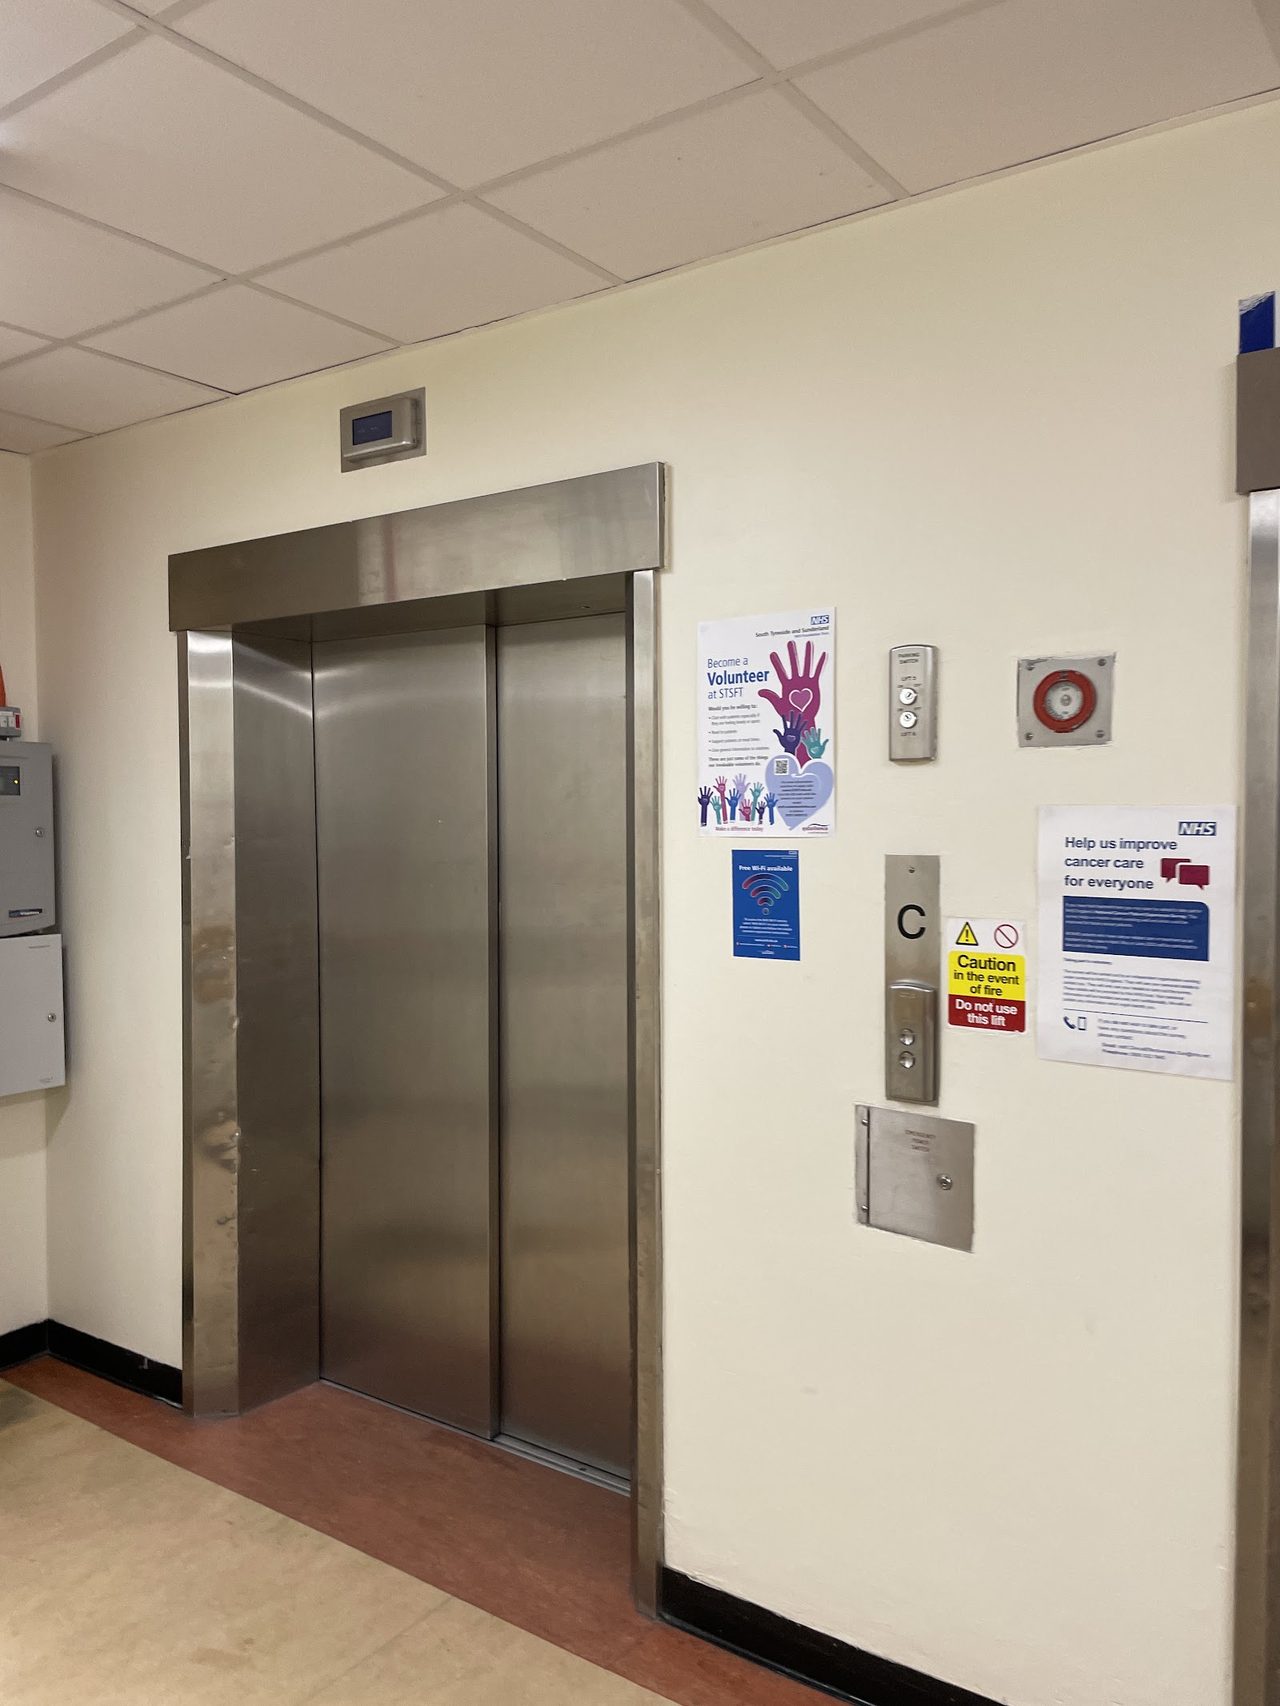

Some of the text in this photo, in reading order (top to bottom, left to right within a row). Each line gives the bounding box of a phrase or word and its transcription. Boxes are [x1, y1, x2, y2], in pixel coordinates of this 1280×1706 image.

[811, 615, 829, 625] NHS
[707, 657, 748, 668] Become a
[707, 670, 770, 686] Volunteer
[708, 687, 744, 700] at STSFT
[1179, 822, 1216, 836] NHS
[1065, 837, 1177, 852] Help us improve
[1064, 857, 1144, 868] cancer care
[1064, 875, 1154, 891] for everyone
[897, 904, 926, 939] C
[958, 954, 1016, 971] Caution
[954, 970, 1019, 985] in the event
[970, 984, 1002, 996] of fire
[956, 999, 1017, 1015] Do not use
[967, 1013, 1006, 1027] this lift
